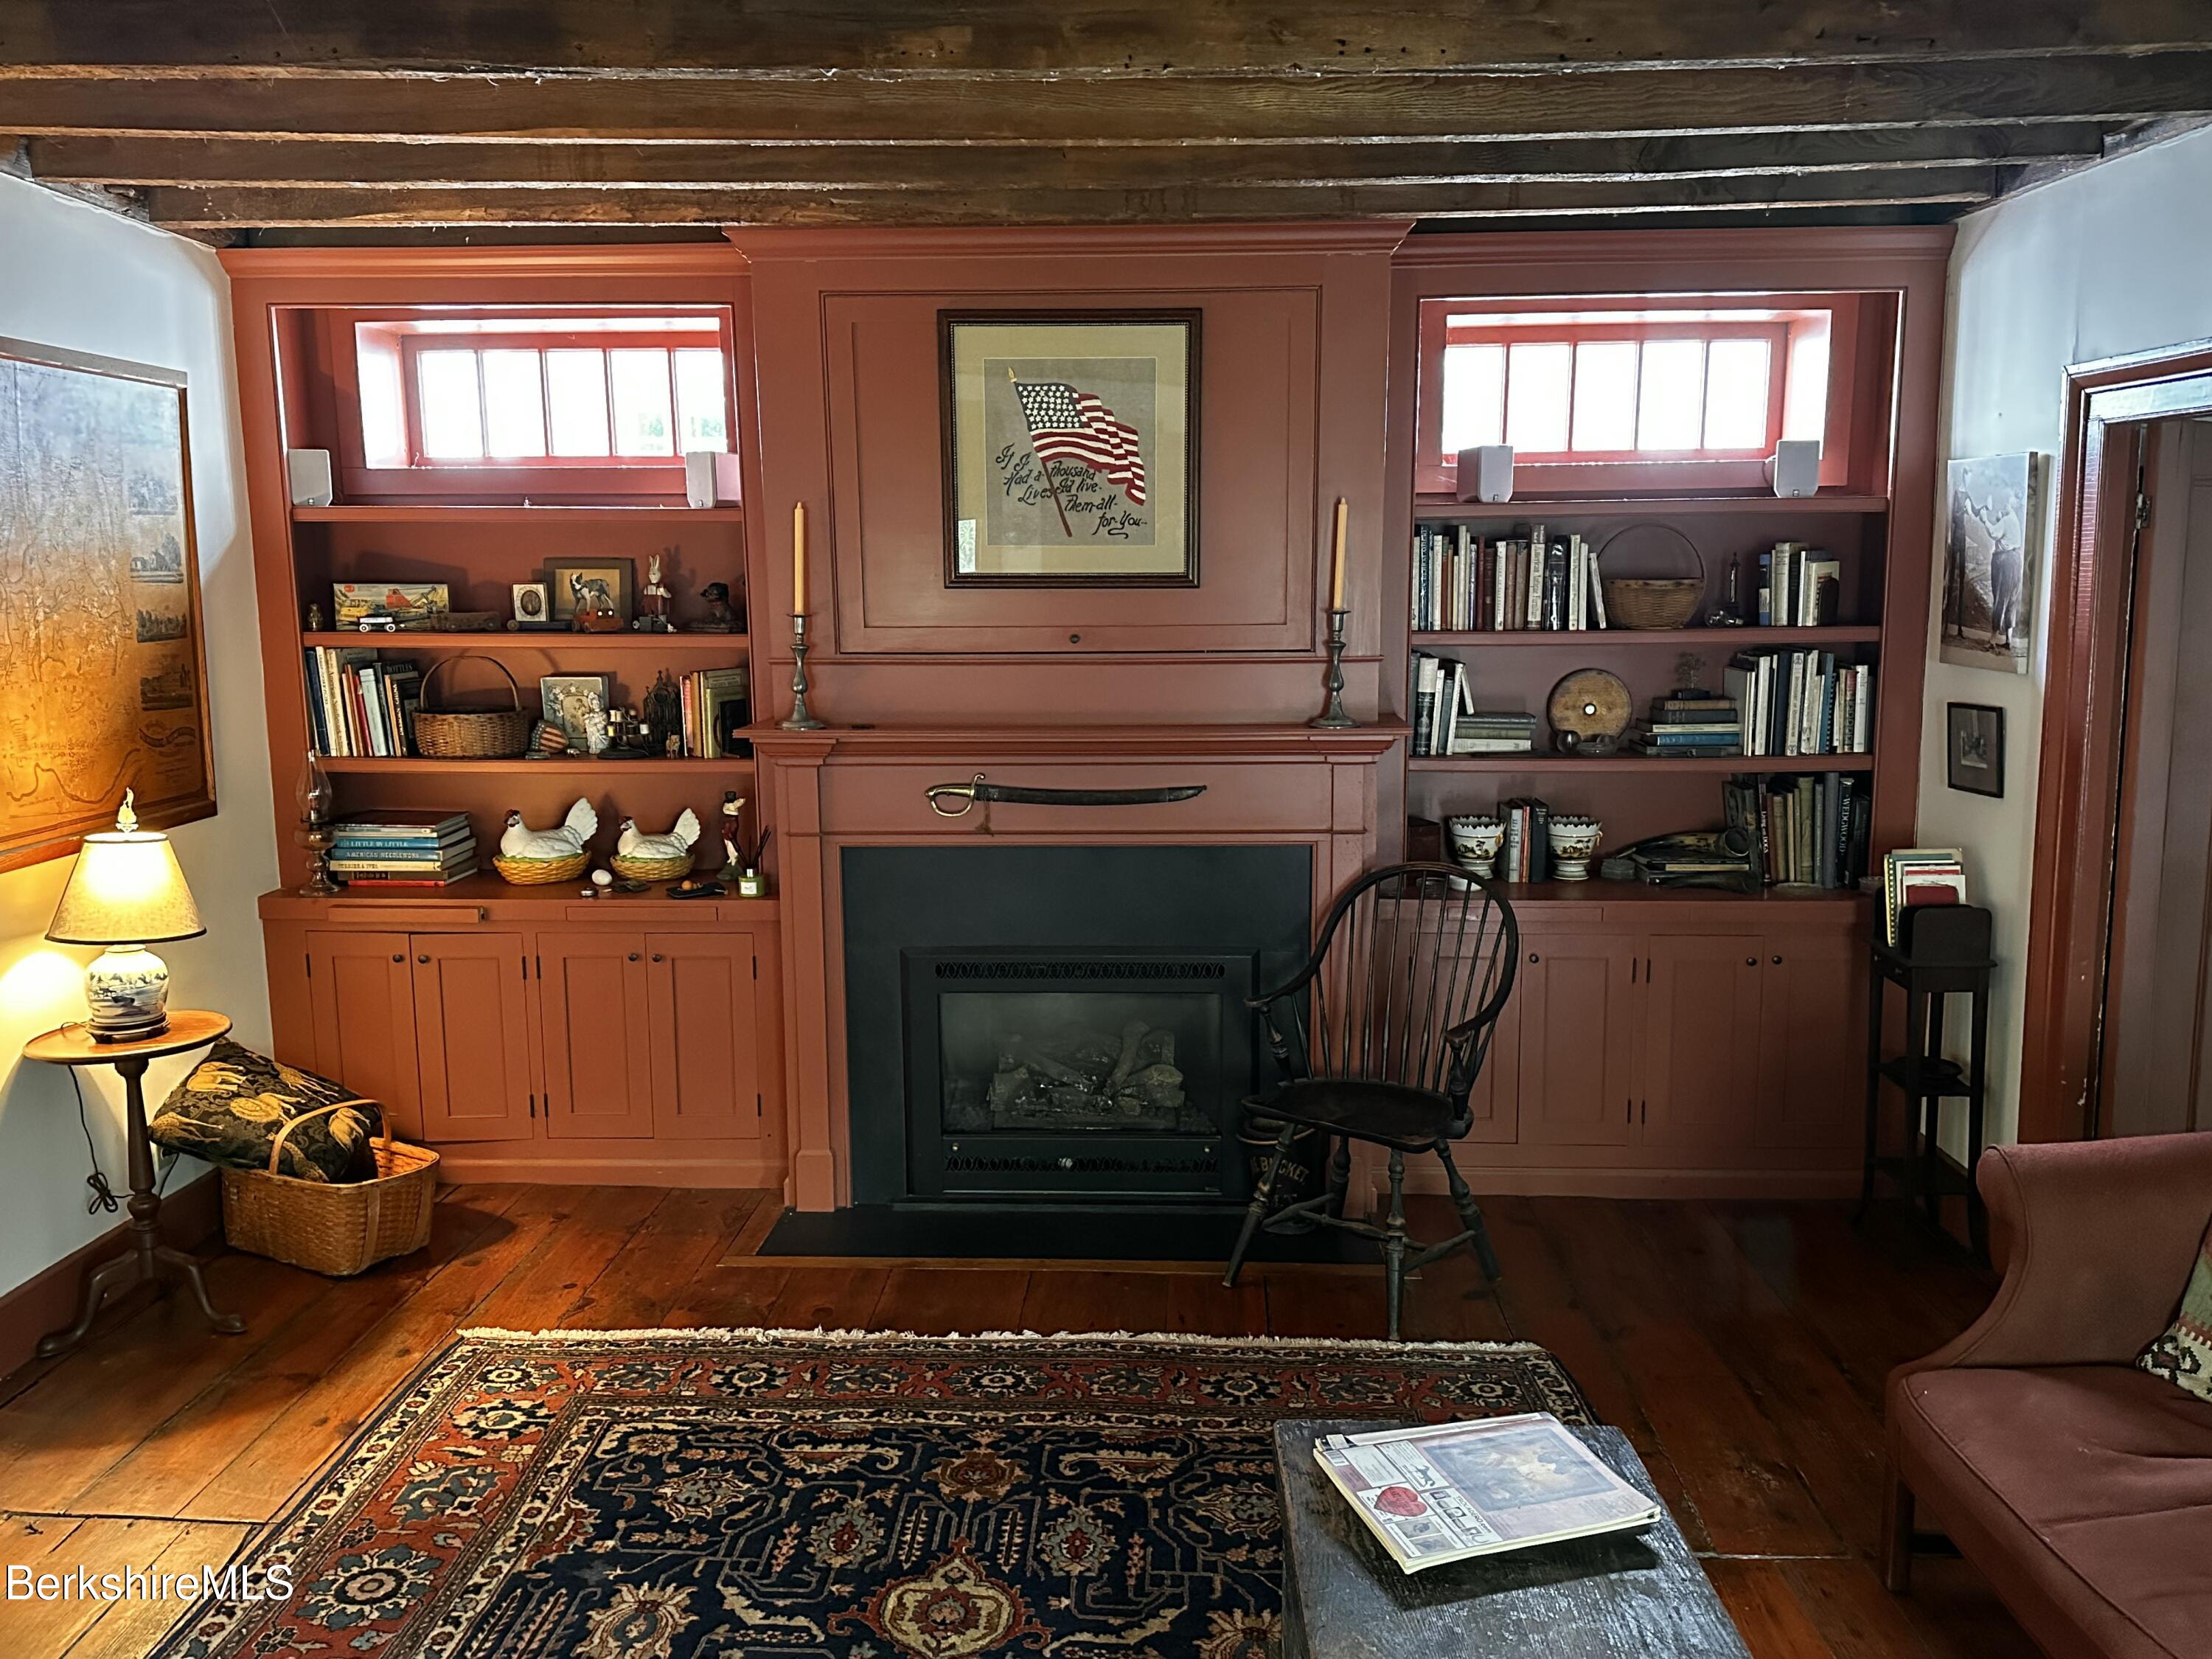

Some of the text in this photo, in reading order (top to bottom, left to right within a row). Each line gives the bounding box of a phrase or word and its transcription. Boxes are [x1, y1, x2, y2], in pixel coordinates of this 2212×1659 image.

[1003, 469, 1034, 496] Had
[1018, 484, 1053, 506] Lives
[1533, 546, 1543, 573] American
[1530, 574, 1542, 594] Antique
[1531, 595, 1541, 620] Furniture
[1838, 798, 1851, 852] WEDGWOOD
[380, 851, 420, 859] NEEDLEWORK
